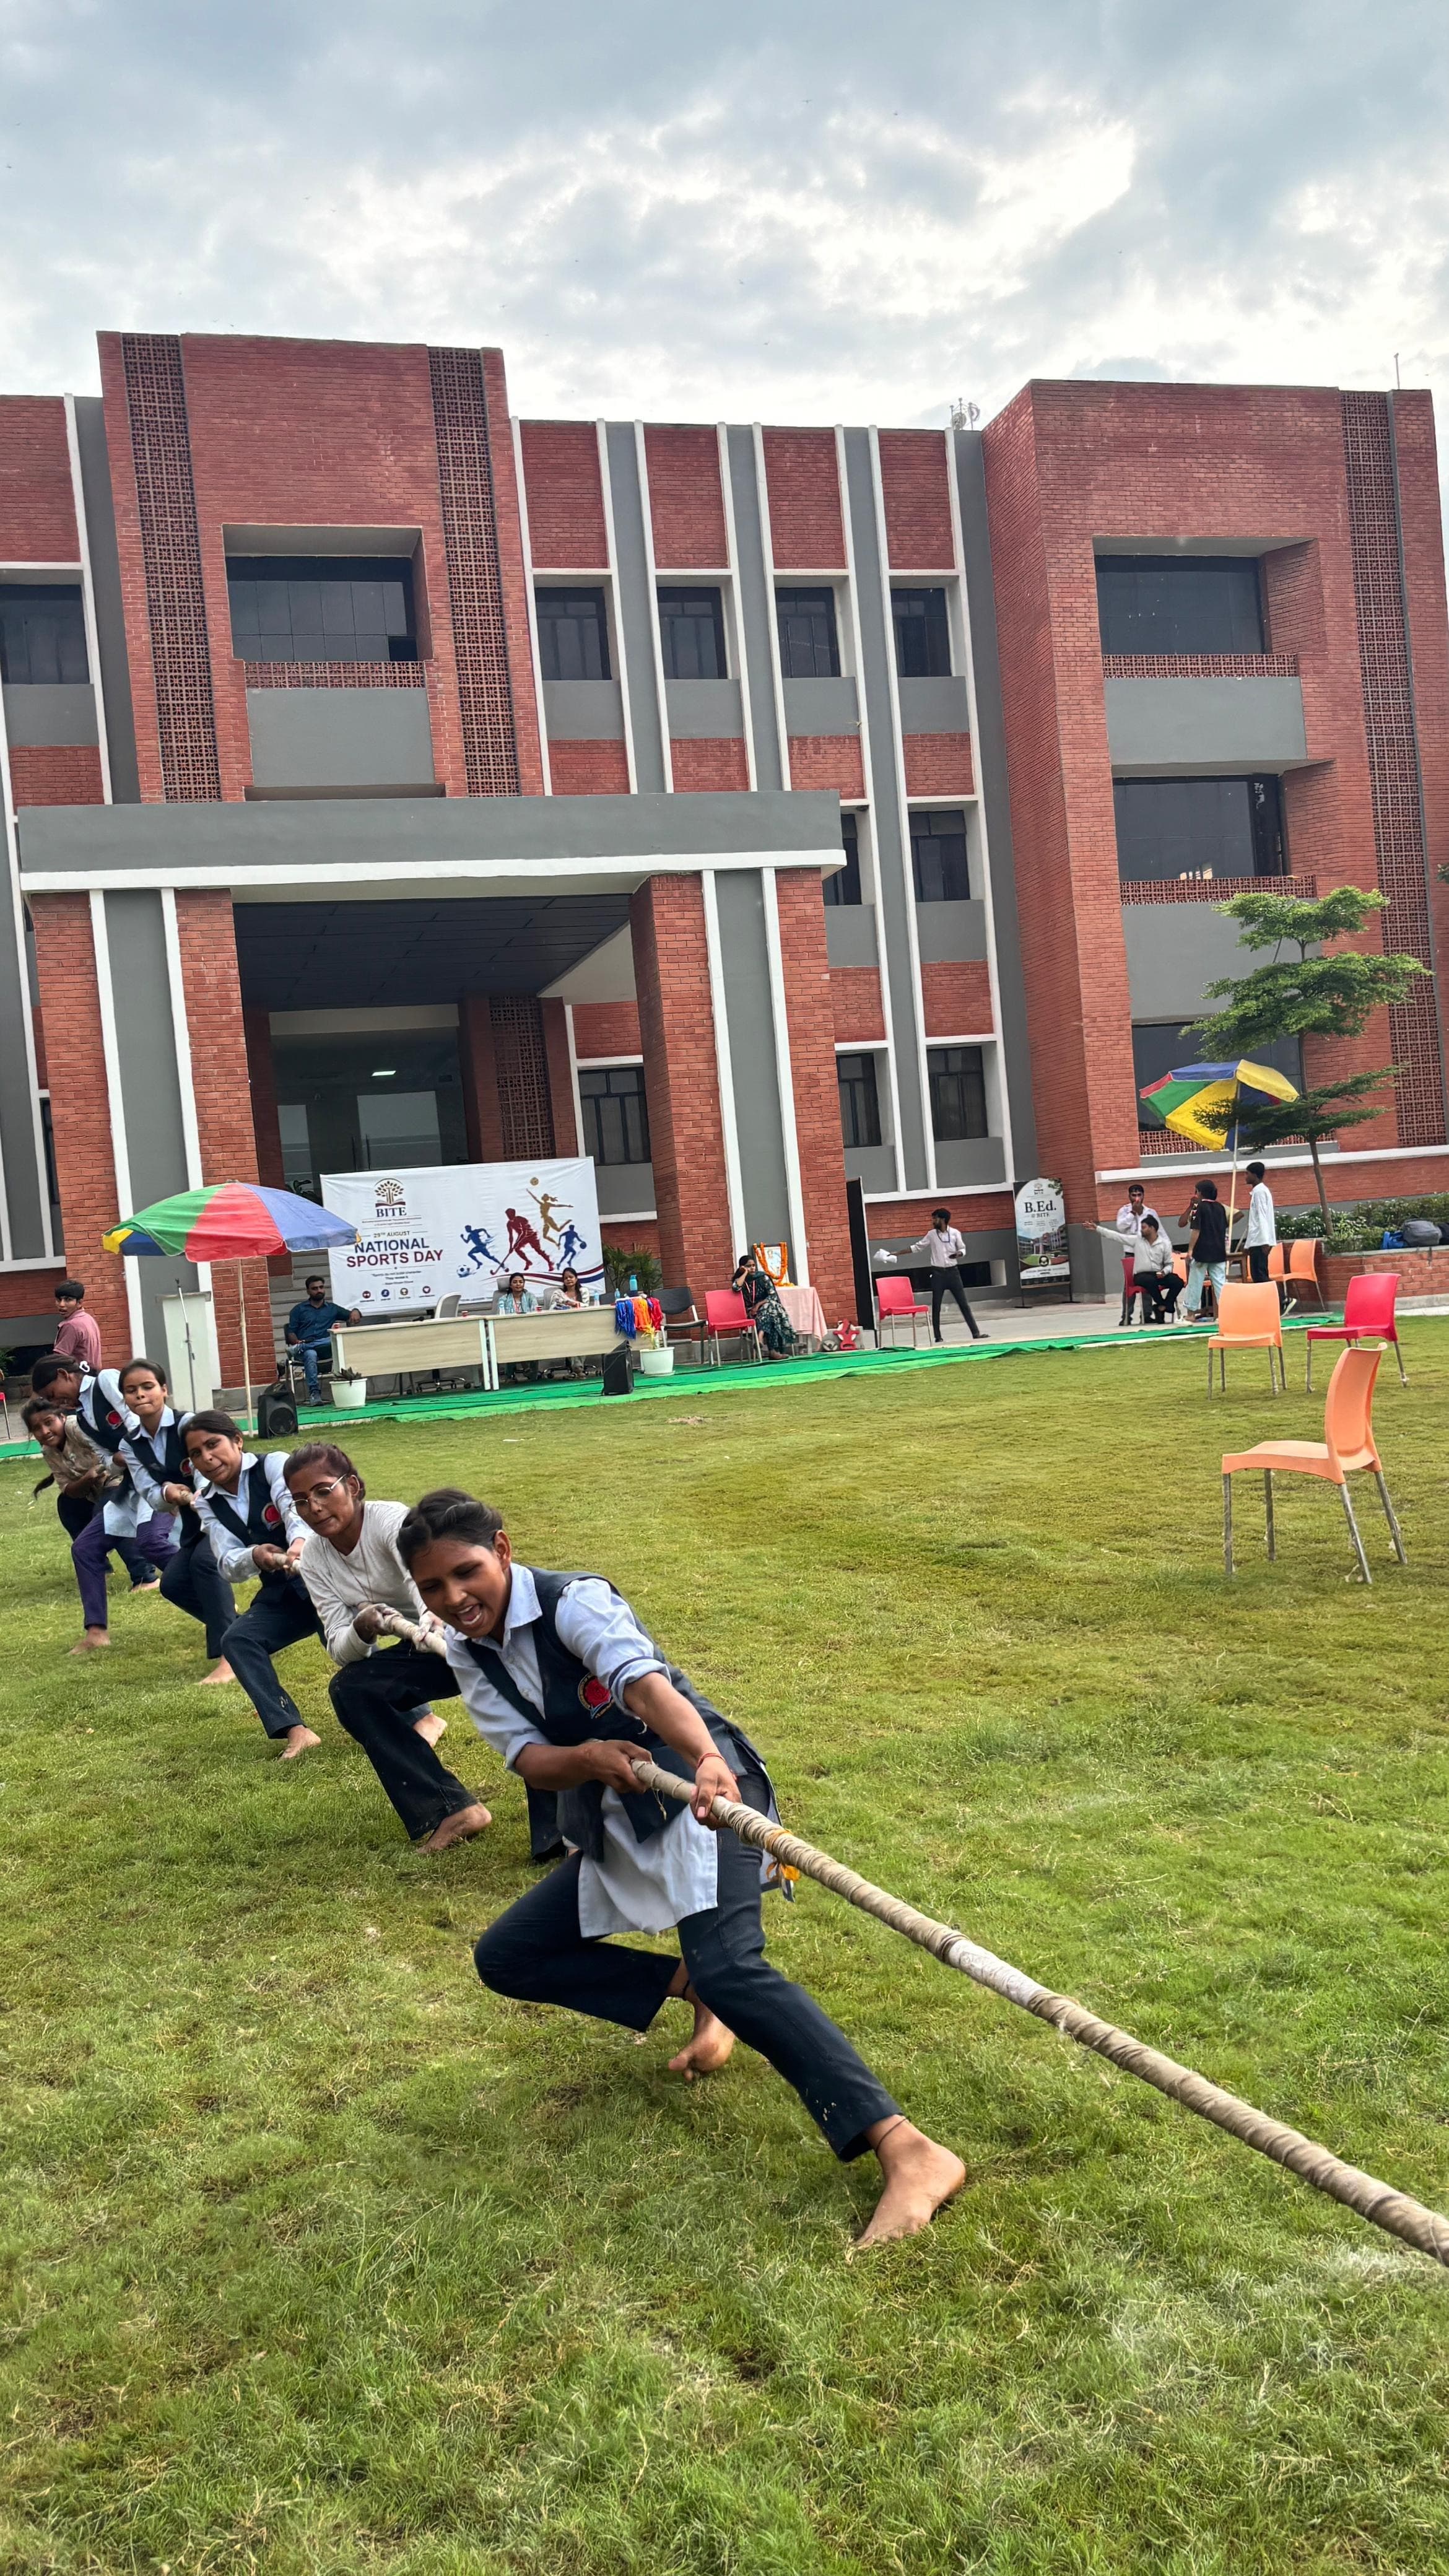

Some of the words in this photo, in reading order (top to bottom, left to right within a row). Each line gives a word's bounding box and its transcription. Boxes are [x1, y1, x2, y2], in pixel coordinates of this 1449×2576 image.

[376, 1207, 407, 1217] BITE
[1024, 1200, 1056, 1213] B.Ed.
[354, 1237, 430, 1254] NATIONAL
[347, 1251, 409, 1268] SPORTS
[414, 1250, 443, 1263] DAY
